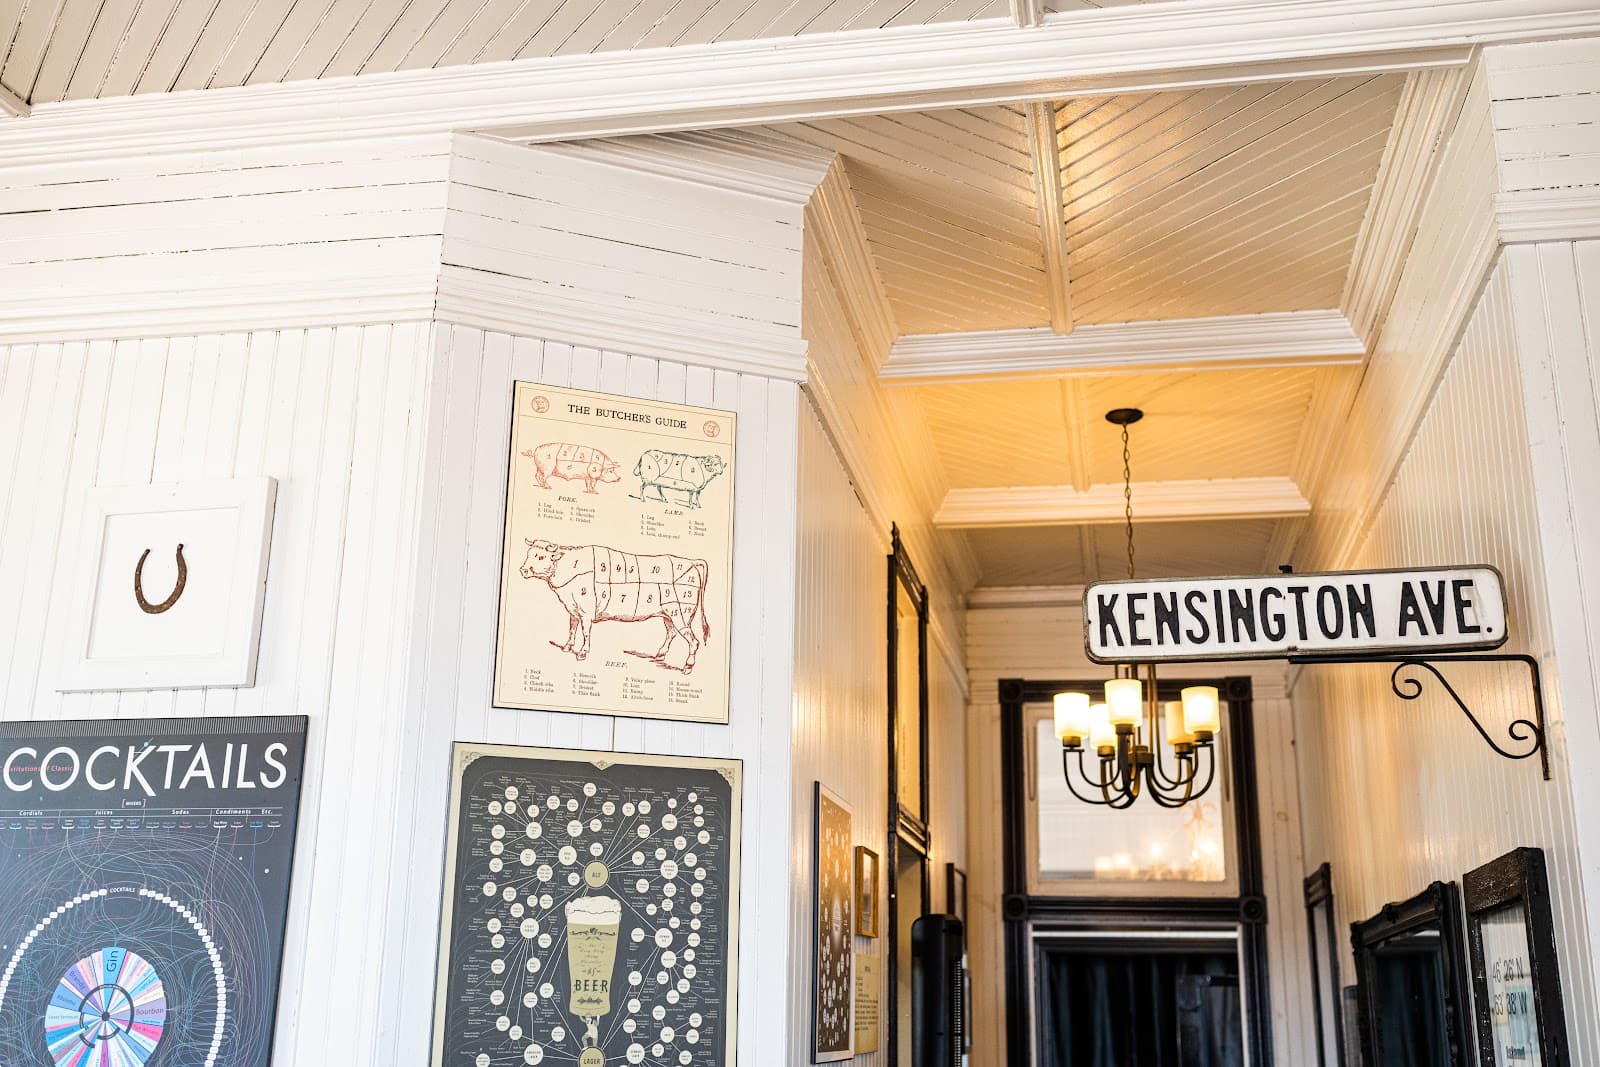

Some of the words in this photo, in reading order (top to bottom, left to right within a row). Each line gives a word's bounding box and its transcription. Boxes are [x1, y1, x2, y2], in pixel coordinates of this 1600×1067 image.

[568, 404, 590, 415] THE
[596, 408, 651, 424] BUTCHER'S
[655, 417, 687, 429] GUIDE
[600, 562, 606, 573] 3
[616, 563, 622, 572] 4
[629, 565, 635, 574] 5
[651, 566, 661, 574] 10
[601, 590, 606, 599] 6
[665, 588, 670, 597] 9
[621, 594, 627, 603] 7
[647, 594, 653, 603] 8
[1097, 583, 1376, 648] KENSINGTON
[1400, 579, 1493, 637] AVE.
[3, 742, 288, 797] COCKTAILS
[106, 950, 119, 972] Gin
[575, 979, 608, 993] BEER
